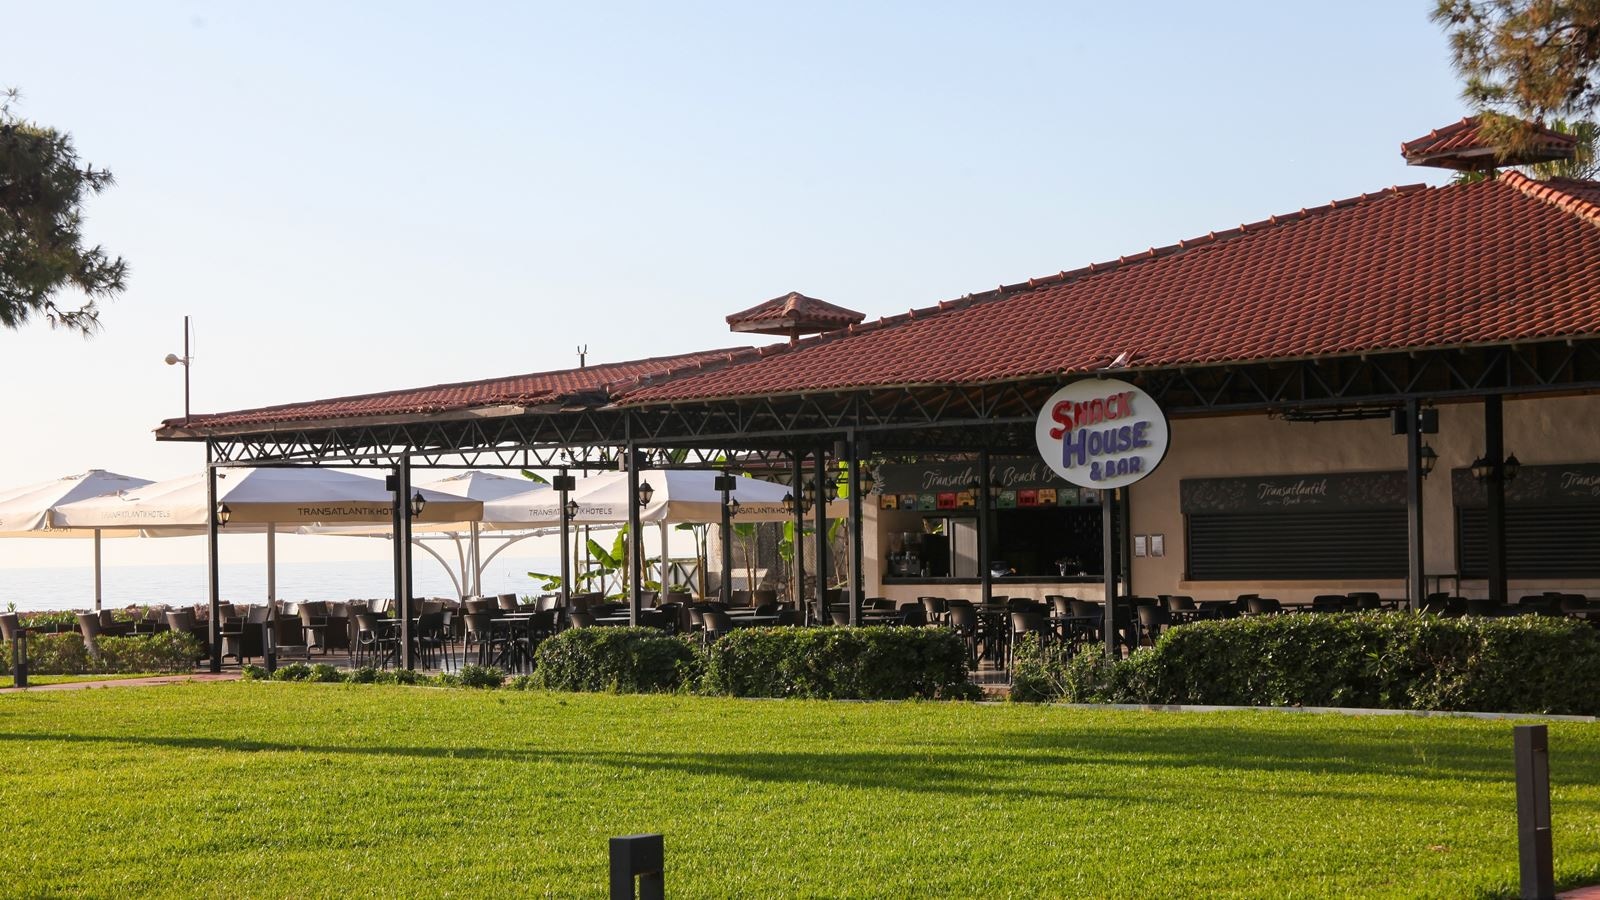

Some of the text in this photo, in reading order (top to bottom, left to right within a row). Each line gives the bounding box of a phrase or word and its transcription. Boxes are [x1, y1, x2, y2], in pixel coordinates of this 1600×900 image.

[1049, 391, 1135, 440] SNACK
[1062, 421, 1150, 468] HOUSE
[922, 467, 996, 489] Transatlank
[1003, 464, 1036, 486] Beach
[1089, 456, 1143, 481] & BAR
[1257, 479, 1327, 499] Transatlantik
